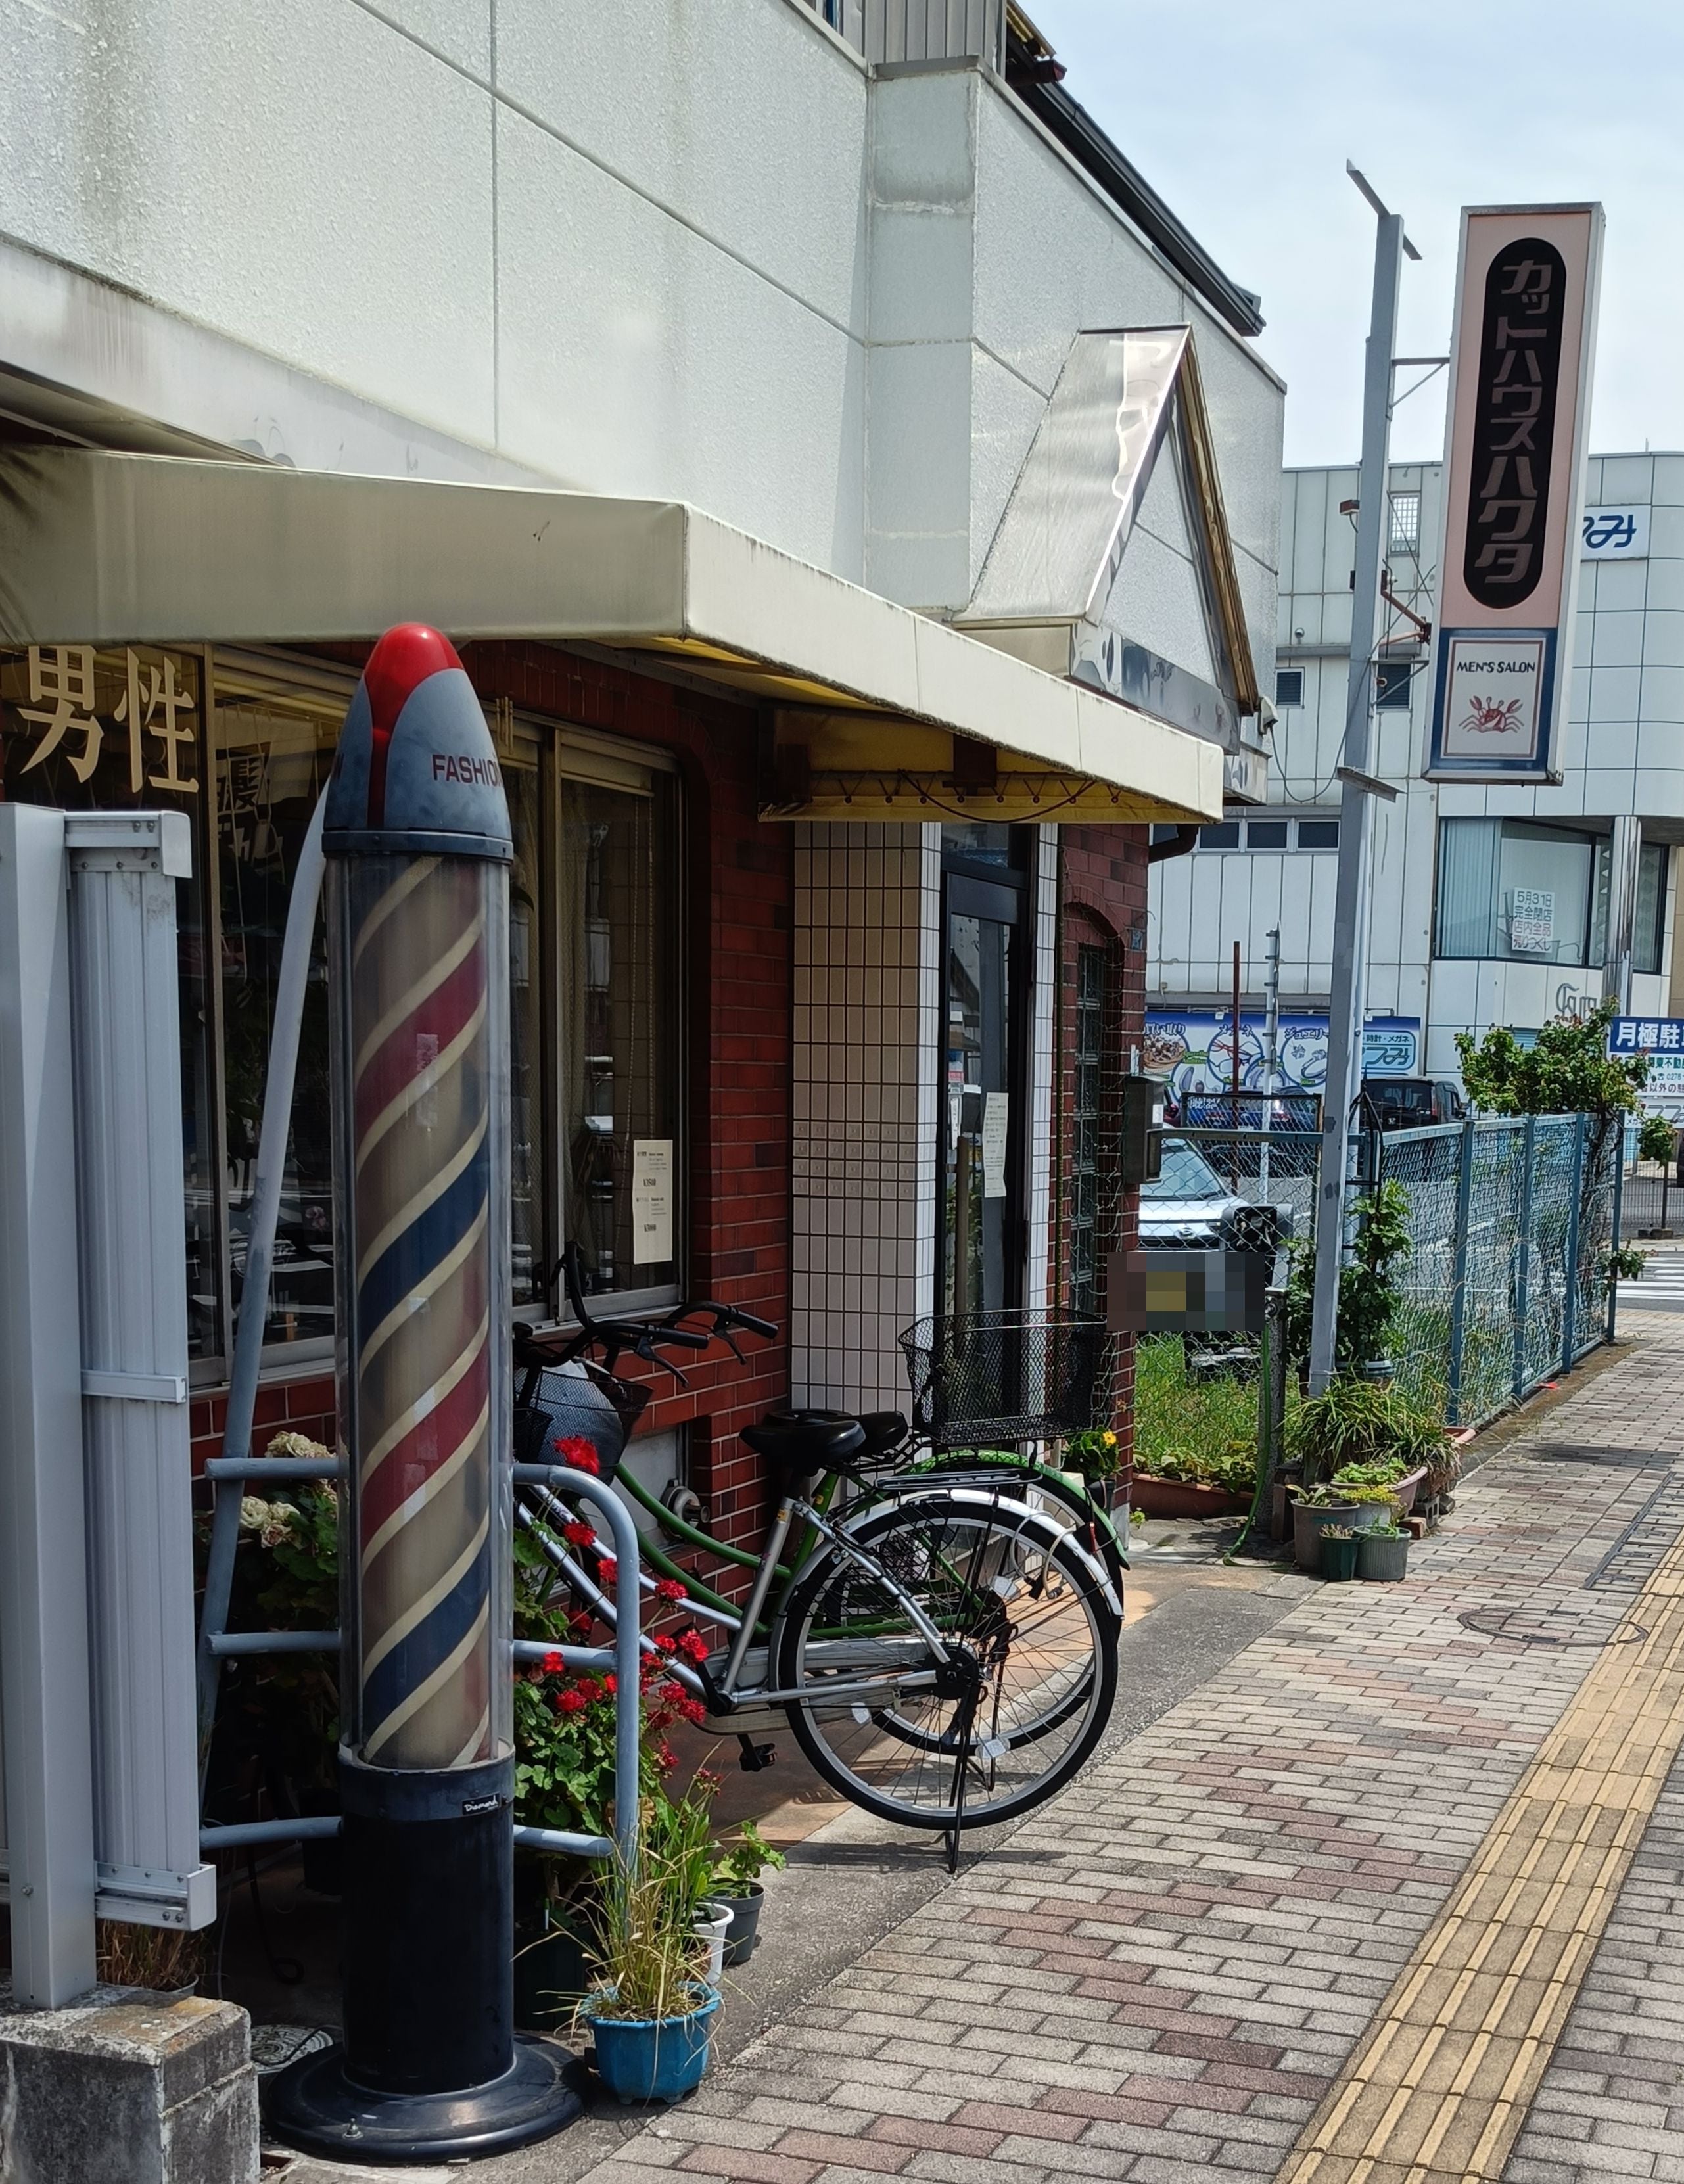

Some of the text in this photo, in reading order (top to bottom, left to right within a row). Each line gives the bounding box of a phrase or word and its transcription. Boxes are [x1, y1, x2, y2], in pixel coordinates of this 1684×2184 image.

[1456, 661, 1535, 674] MEN'S SALON
[18, 645, 199, 793] 男性
[1517, 891, 1552, 908] 5月31日
[1514, 905, 1553, 922] 完全閉店
[1513, 920, 1551, 937] 店内全品
[1616, 1021, 1684, 1049] 月極駐
[1362, 1046, 1411, 1065] つみ
